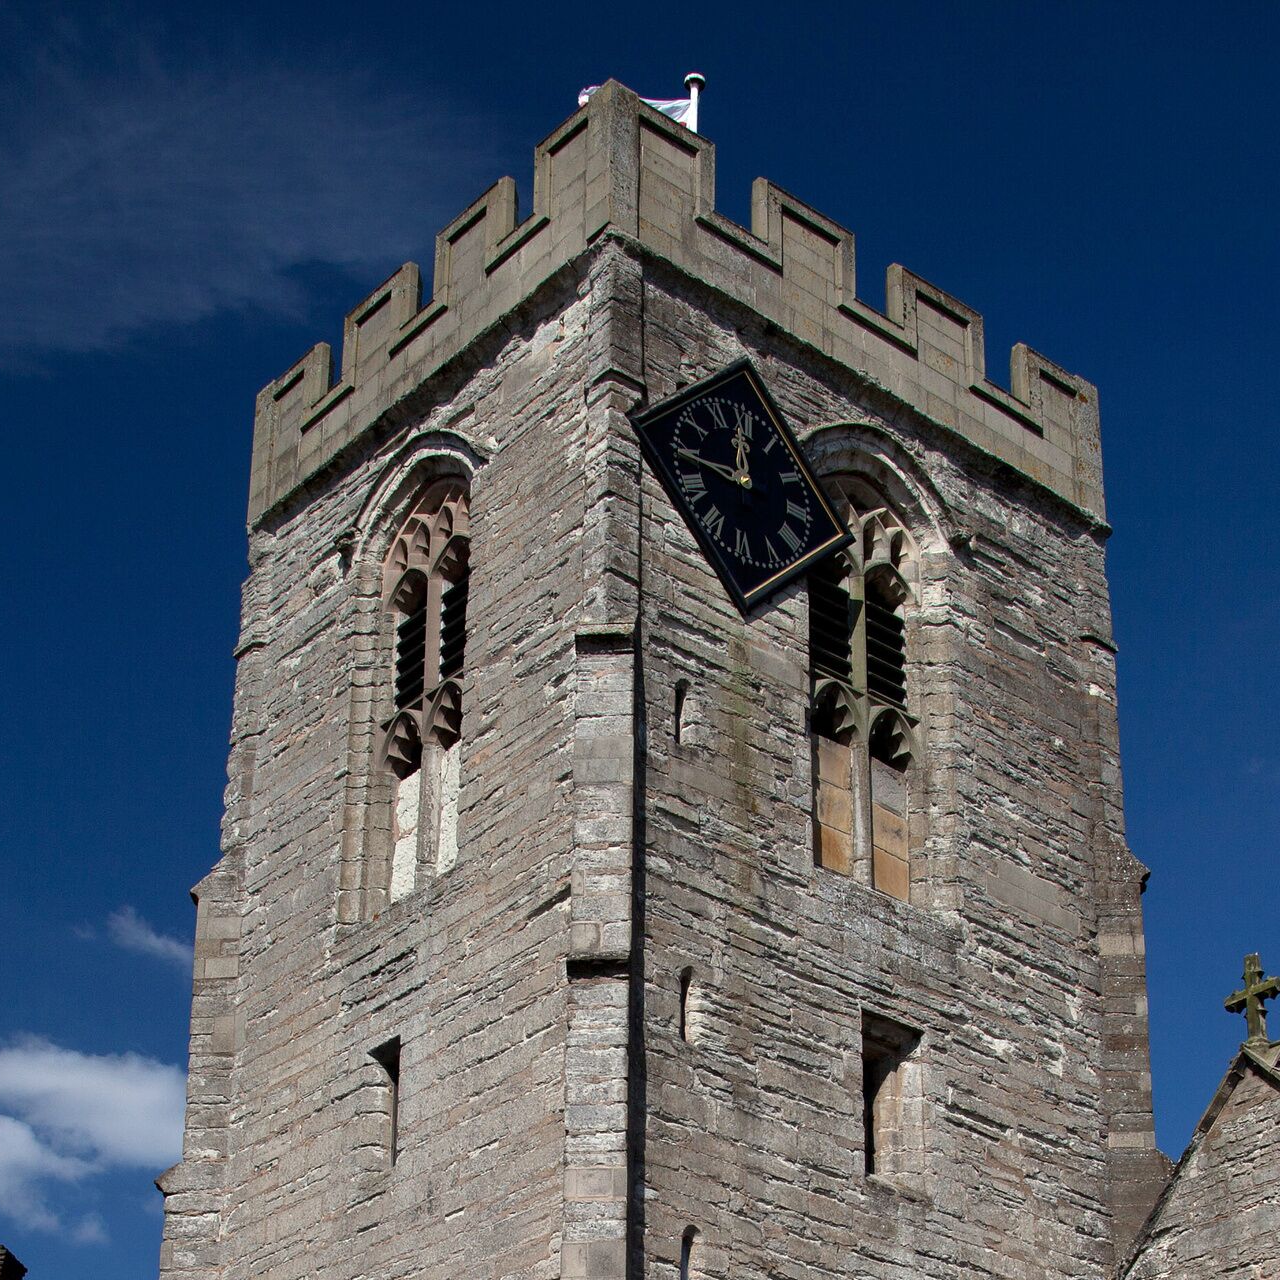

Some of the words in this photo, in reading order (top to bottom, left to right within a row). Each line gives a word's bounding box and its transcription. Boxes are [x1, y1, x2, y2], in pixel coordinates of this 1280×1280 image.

[684, 411, 708, 442] X
[705, 402, 729, 430] XI
[762, 436, 777, 455] I
[779, 471, 799, 484] II
[702, 504, 724, 539] VII
[786, 499, 807, 523] III
[735, 528, 752, 560] VI
[764, 535, 781, 564] V
